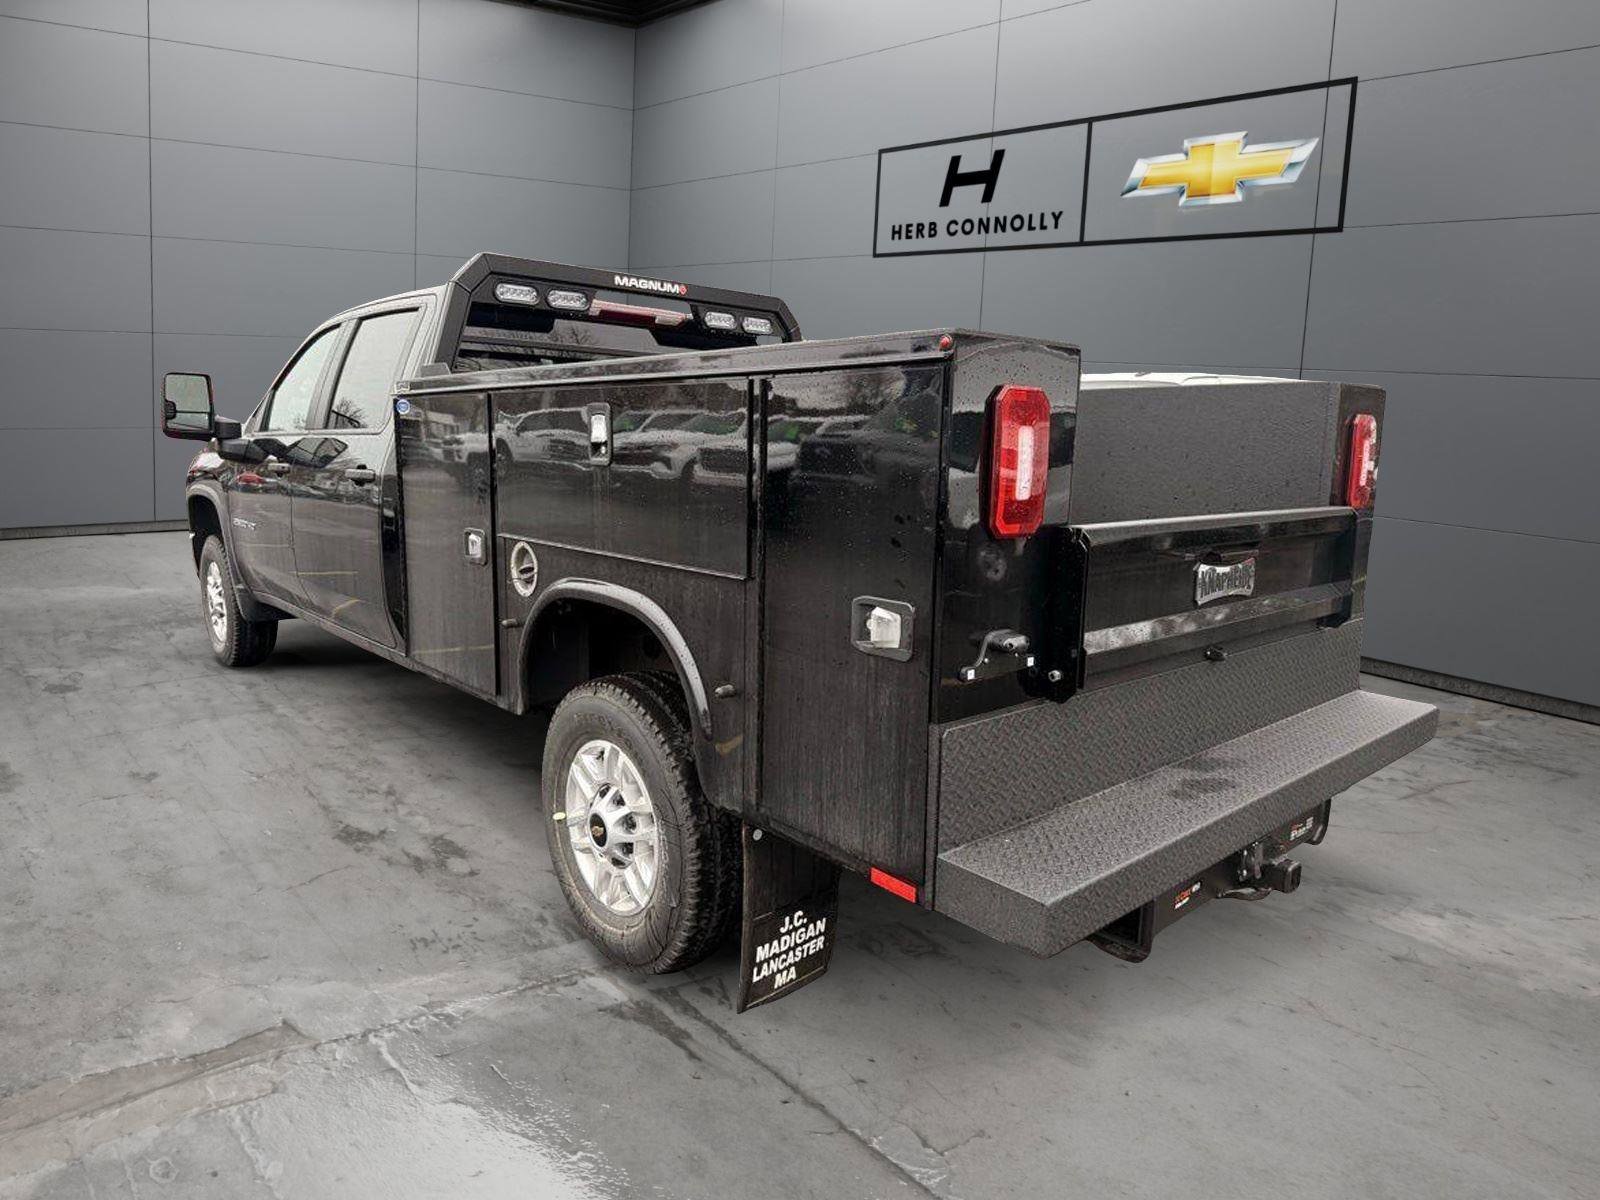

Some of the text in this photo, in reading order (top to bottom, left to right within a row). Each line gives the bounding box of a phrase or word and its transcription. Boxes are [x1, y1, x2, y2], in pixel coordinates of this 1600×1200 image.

[939, 149, 1006, 208] H
[891, 211, 1063, 241] HERB CONNOLLY
[614, 275, 680, 294] MAGNUM
[779, 910, 808, 933] J.C.
[755, 917, 827, 963] MADIGAN
[752, 935, 825, 983] LANCASTER
[774, 966, 797, 989] MA
